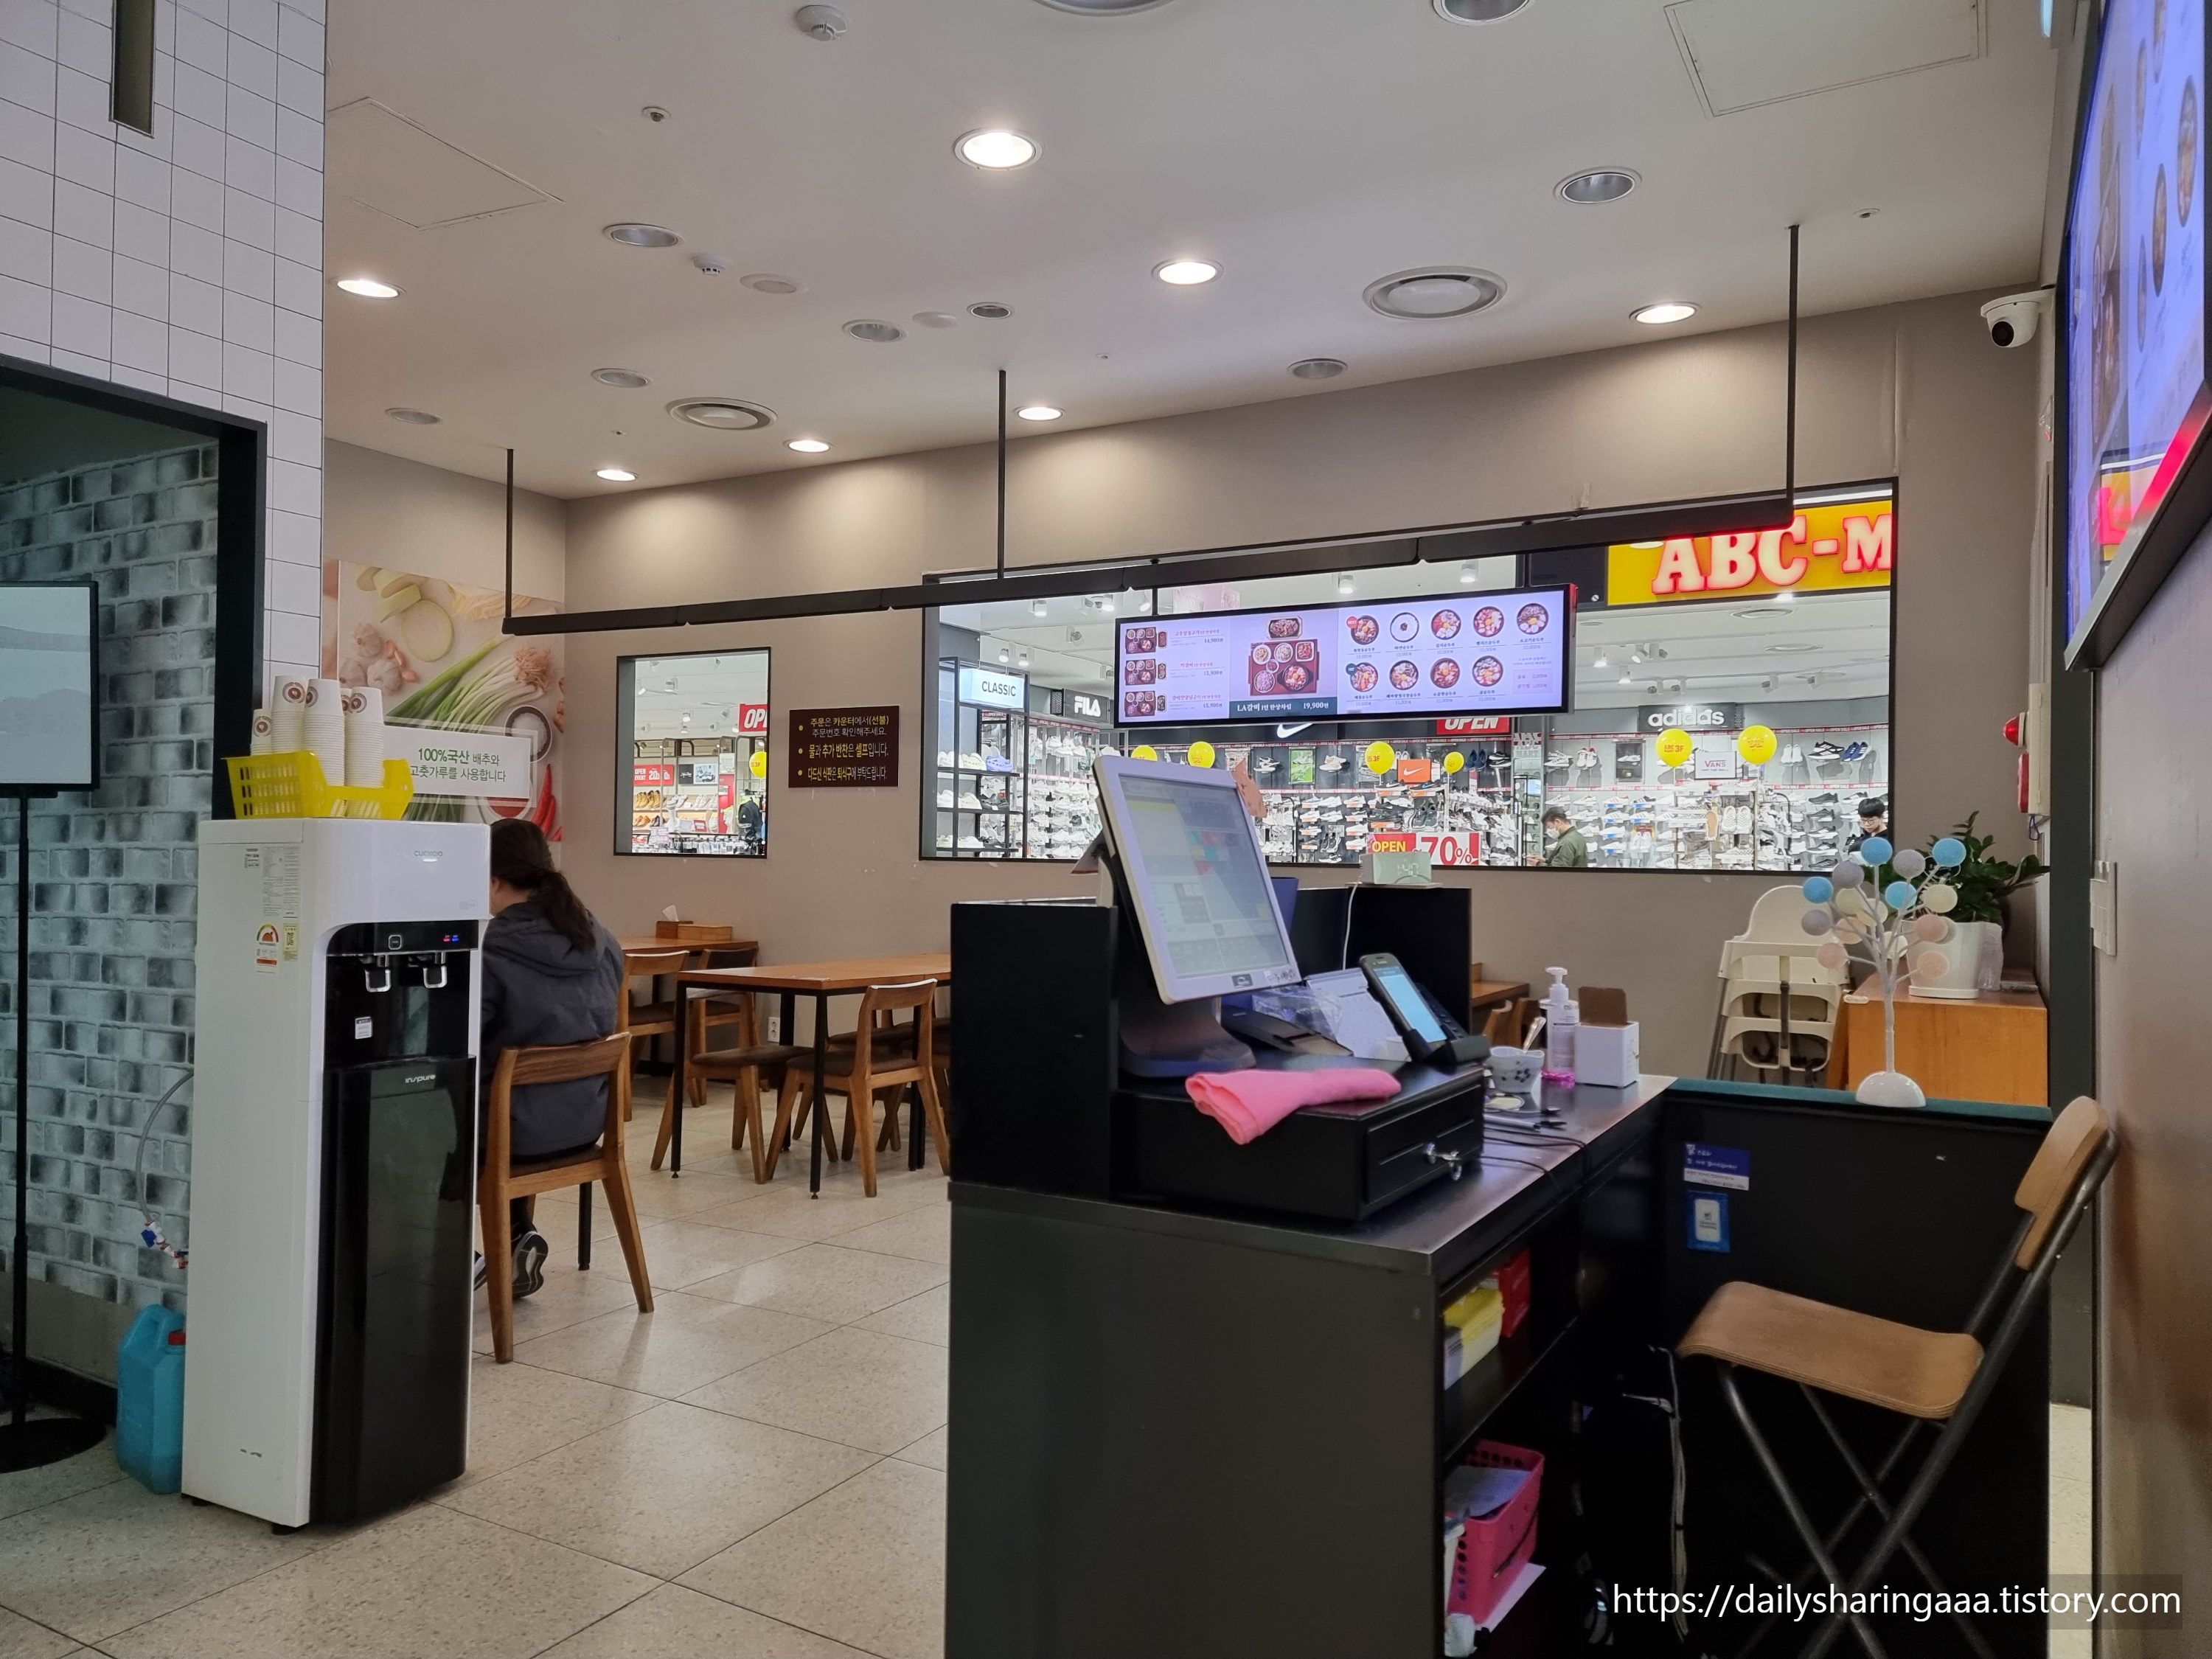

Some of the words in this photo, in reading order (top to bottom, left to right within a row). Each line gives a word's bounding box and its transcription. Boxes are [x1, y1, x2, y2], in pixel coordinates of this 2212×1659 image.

[981, 681, 1017, 697] CLASSIC
[1074, 695, 1102, 717] FILA
[1303, 702, 1329, 710] 19,900원
[810, 717, 831, 727] 주문은
[1444, 717, 1499, 731] OPEN
[1648, 708, 1725, 727] adidas
[812, 728, 840, 737] 주문번호
[809, 744, 821, 759] 물과
[822, 743, 835, 758] 추가
[835, 743, 854, 758] 반찬은
[855, 742, 888, 757] 셀프입니다.
[1675, 745, 1685, 753] 3F
[418, 748, 470, 765] 100%국산
[473, 753, 500, 767] 배추와
[1704, 759, 1727, 768] VANS
[410, 765, 458, 780] 고춧가루를
[460, 768, 507, 782] 사용합니다
[1371, 841, 1406, 852] OPEN
